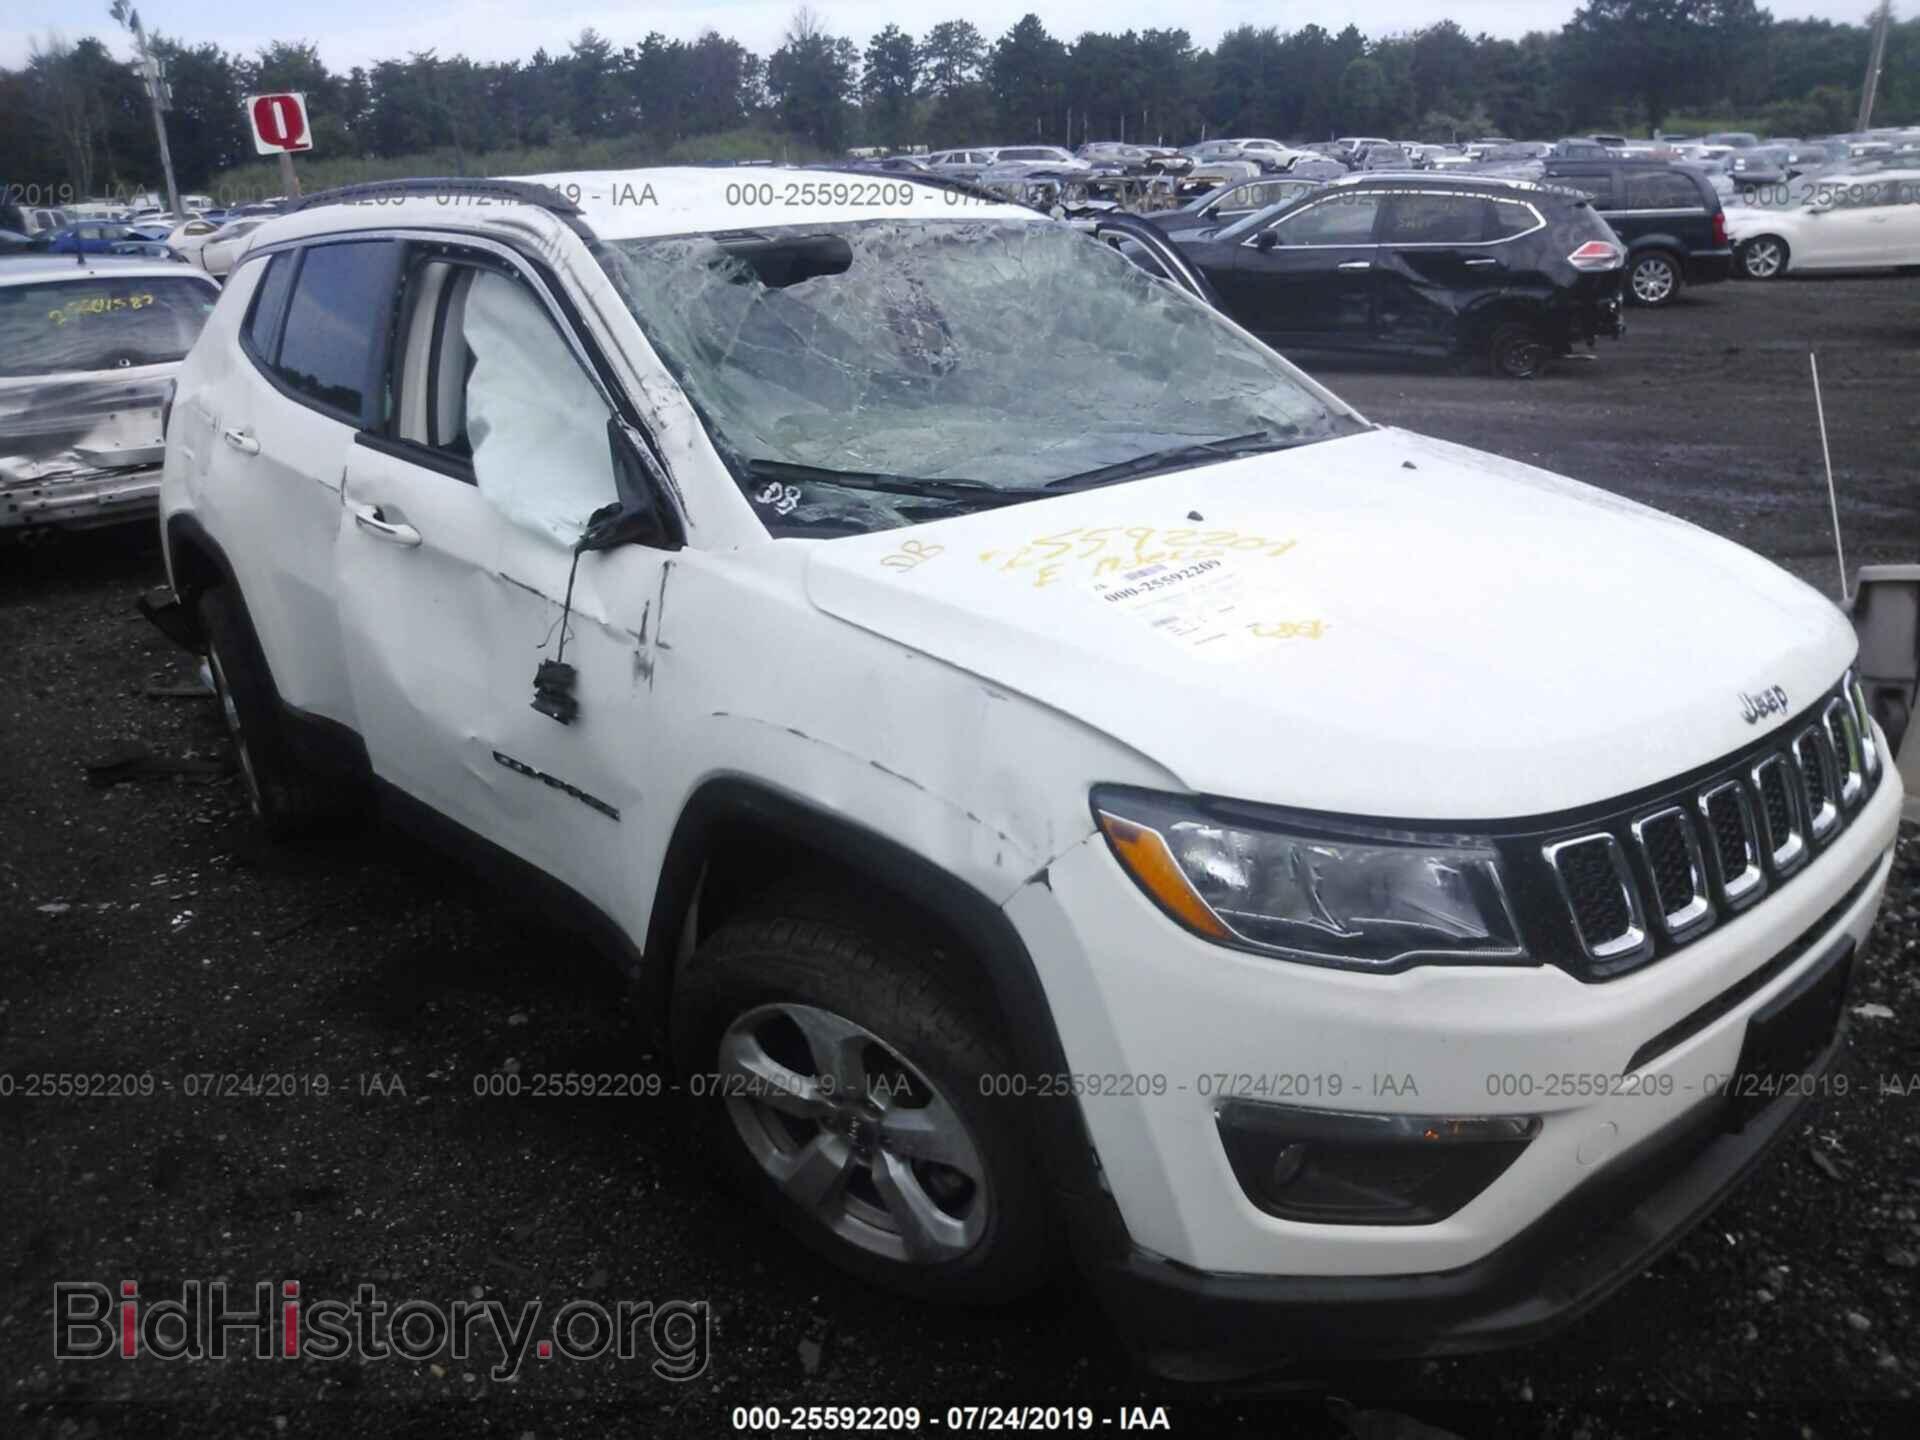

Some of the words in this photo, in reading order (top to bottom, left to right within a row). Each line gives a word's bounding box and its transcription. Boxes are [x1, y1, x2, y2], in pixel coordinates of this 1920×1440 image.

[254, 95, 309, 150] Q
[1104, 558, 1223, 603] 000-25592209
[1738, 684, 1788, 725] Jeep
